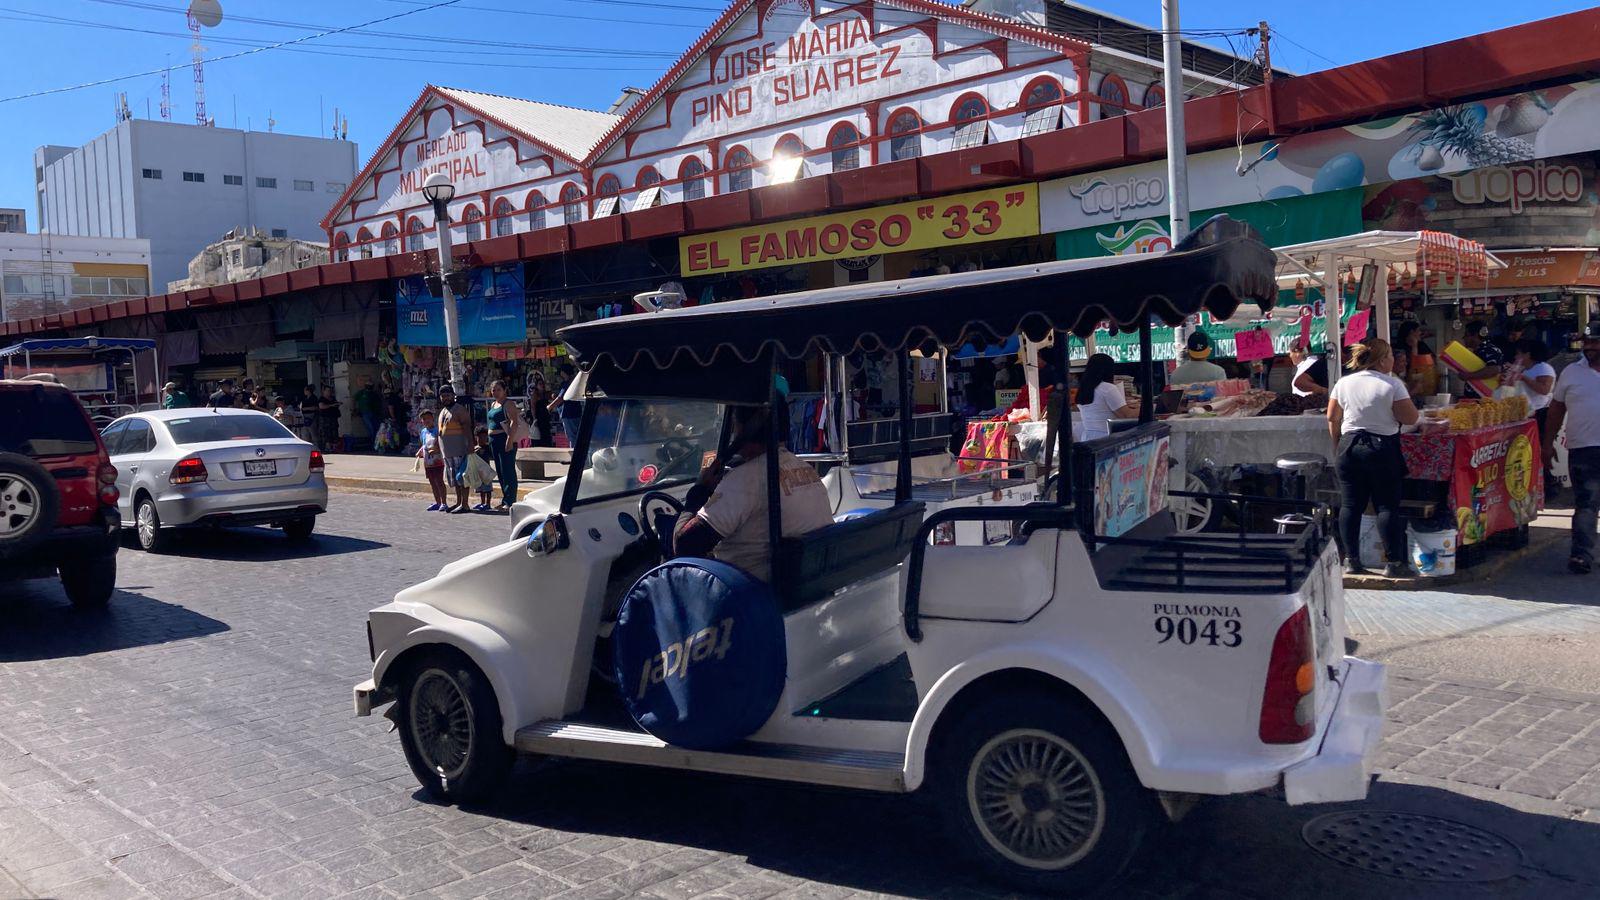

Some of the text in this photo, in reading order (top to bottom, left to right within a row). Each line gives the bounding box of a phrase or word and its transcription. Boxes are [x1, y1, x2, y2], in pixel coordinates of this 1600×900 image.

[715, 17, 869, 84] JOSE MARIA
[691, 45, 902, 127] PINO SUAREZ
[416, 130, 468, 163] MERCADO
[1069, 176, 1166, 219] tropico
[687, 240, 730, 271] EL
[740, 214, 912, 265] FAMOSO
[410, 309, 428, 322] mzt
[1153, 603, 1242, 618] PULMONIA
[1154, 616, 1243, 648] 9043
